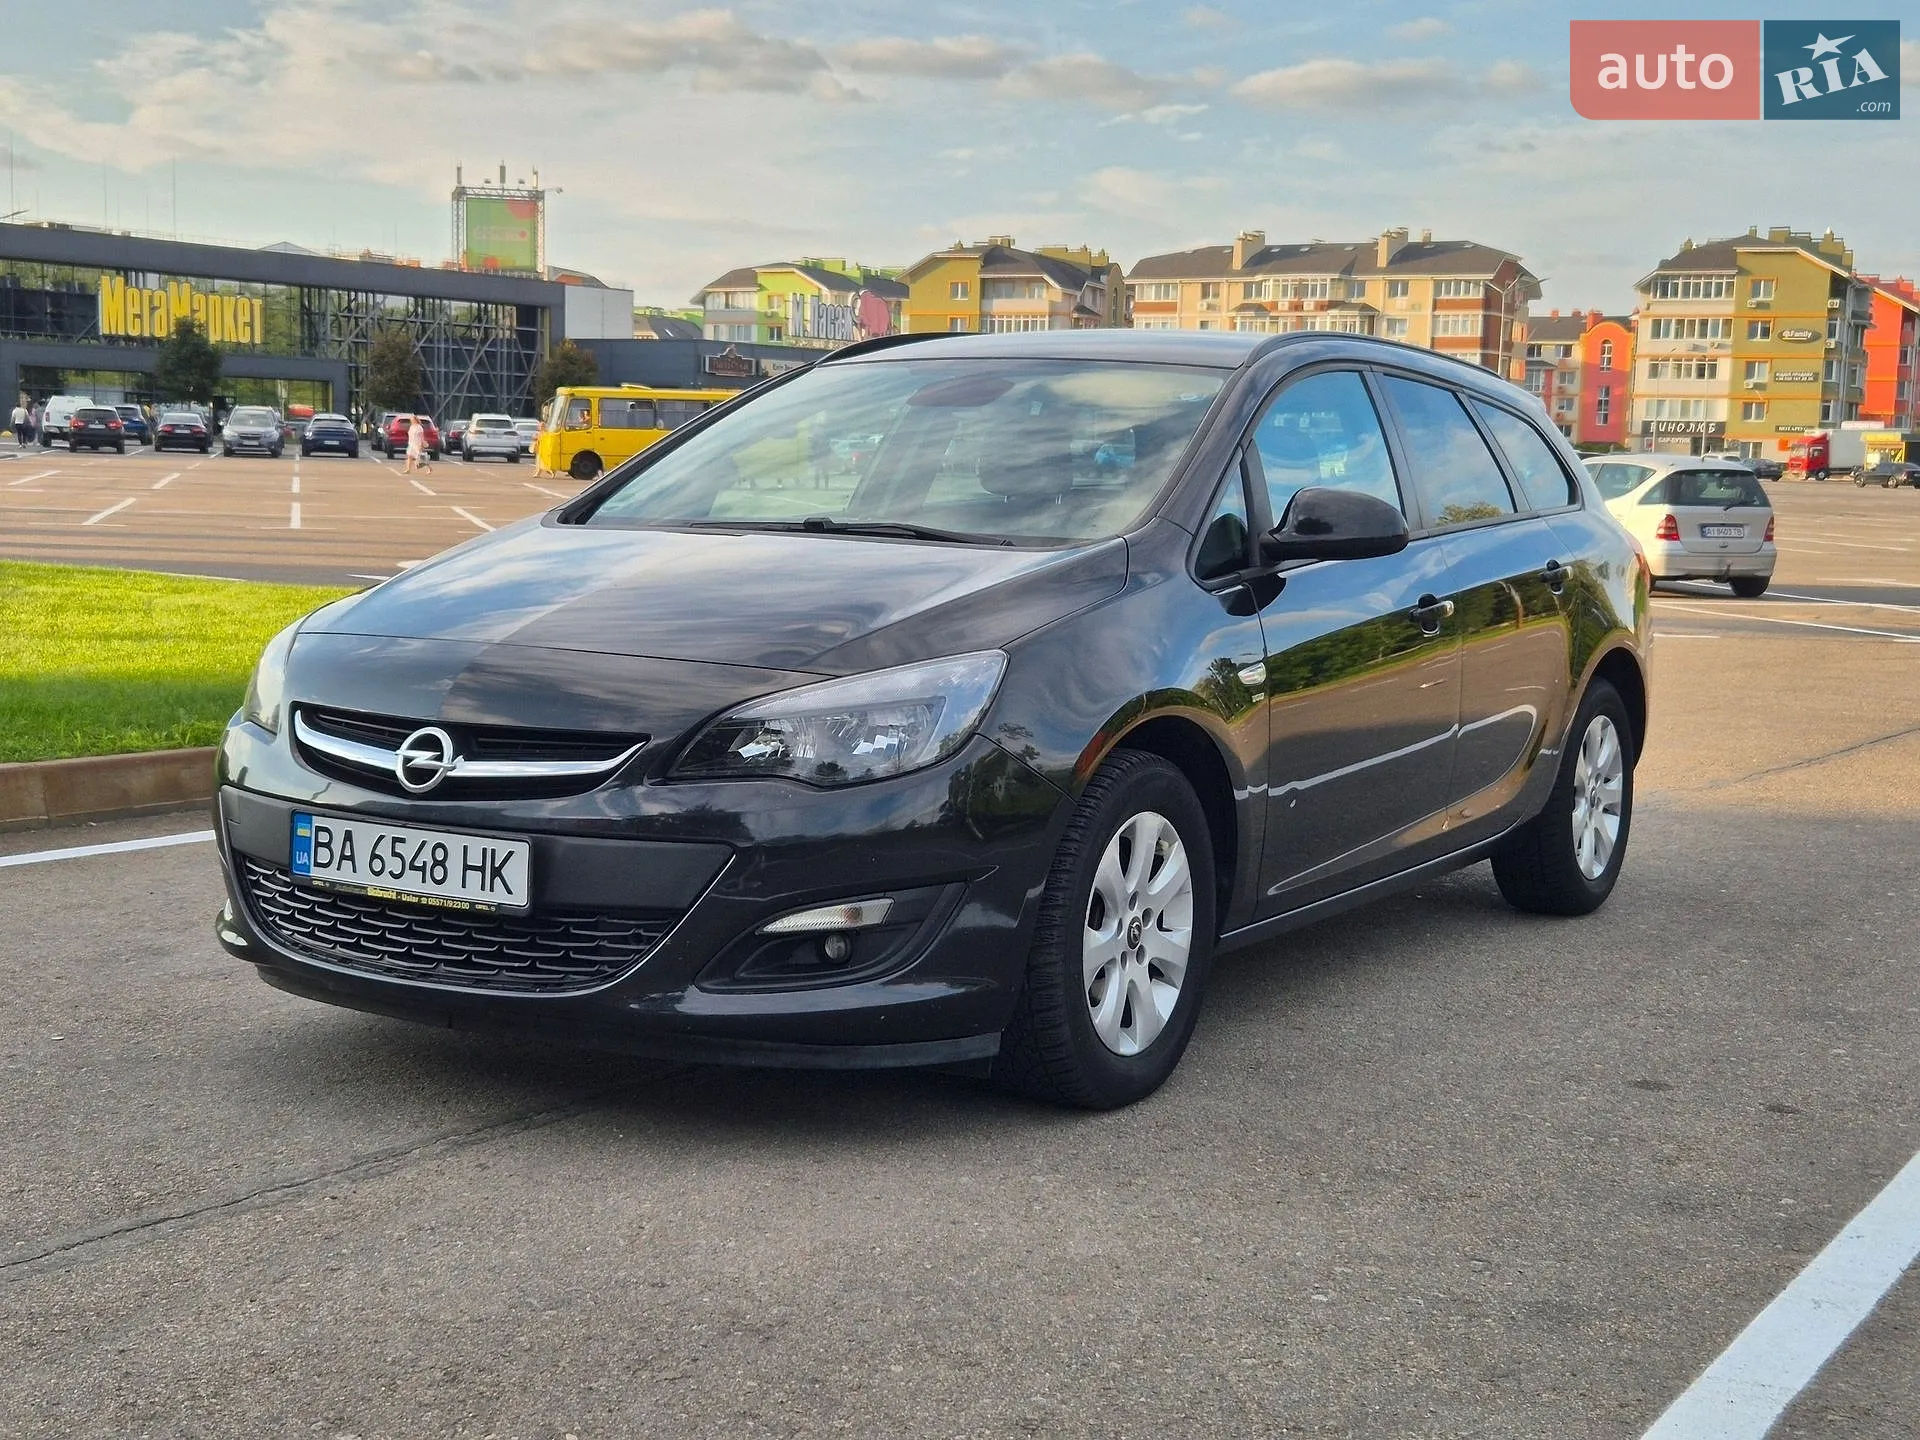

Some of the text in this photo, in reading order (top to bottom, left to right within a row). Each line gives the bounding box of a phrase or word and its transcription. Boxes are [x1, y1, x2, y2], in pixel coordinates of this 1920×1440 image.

[296, 851, 309, 865] UA
[313, 825, 515, 895] BA 6548 HK
